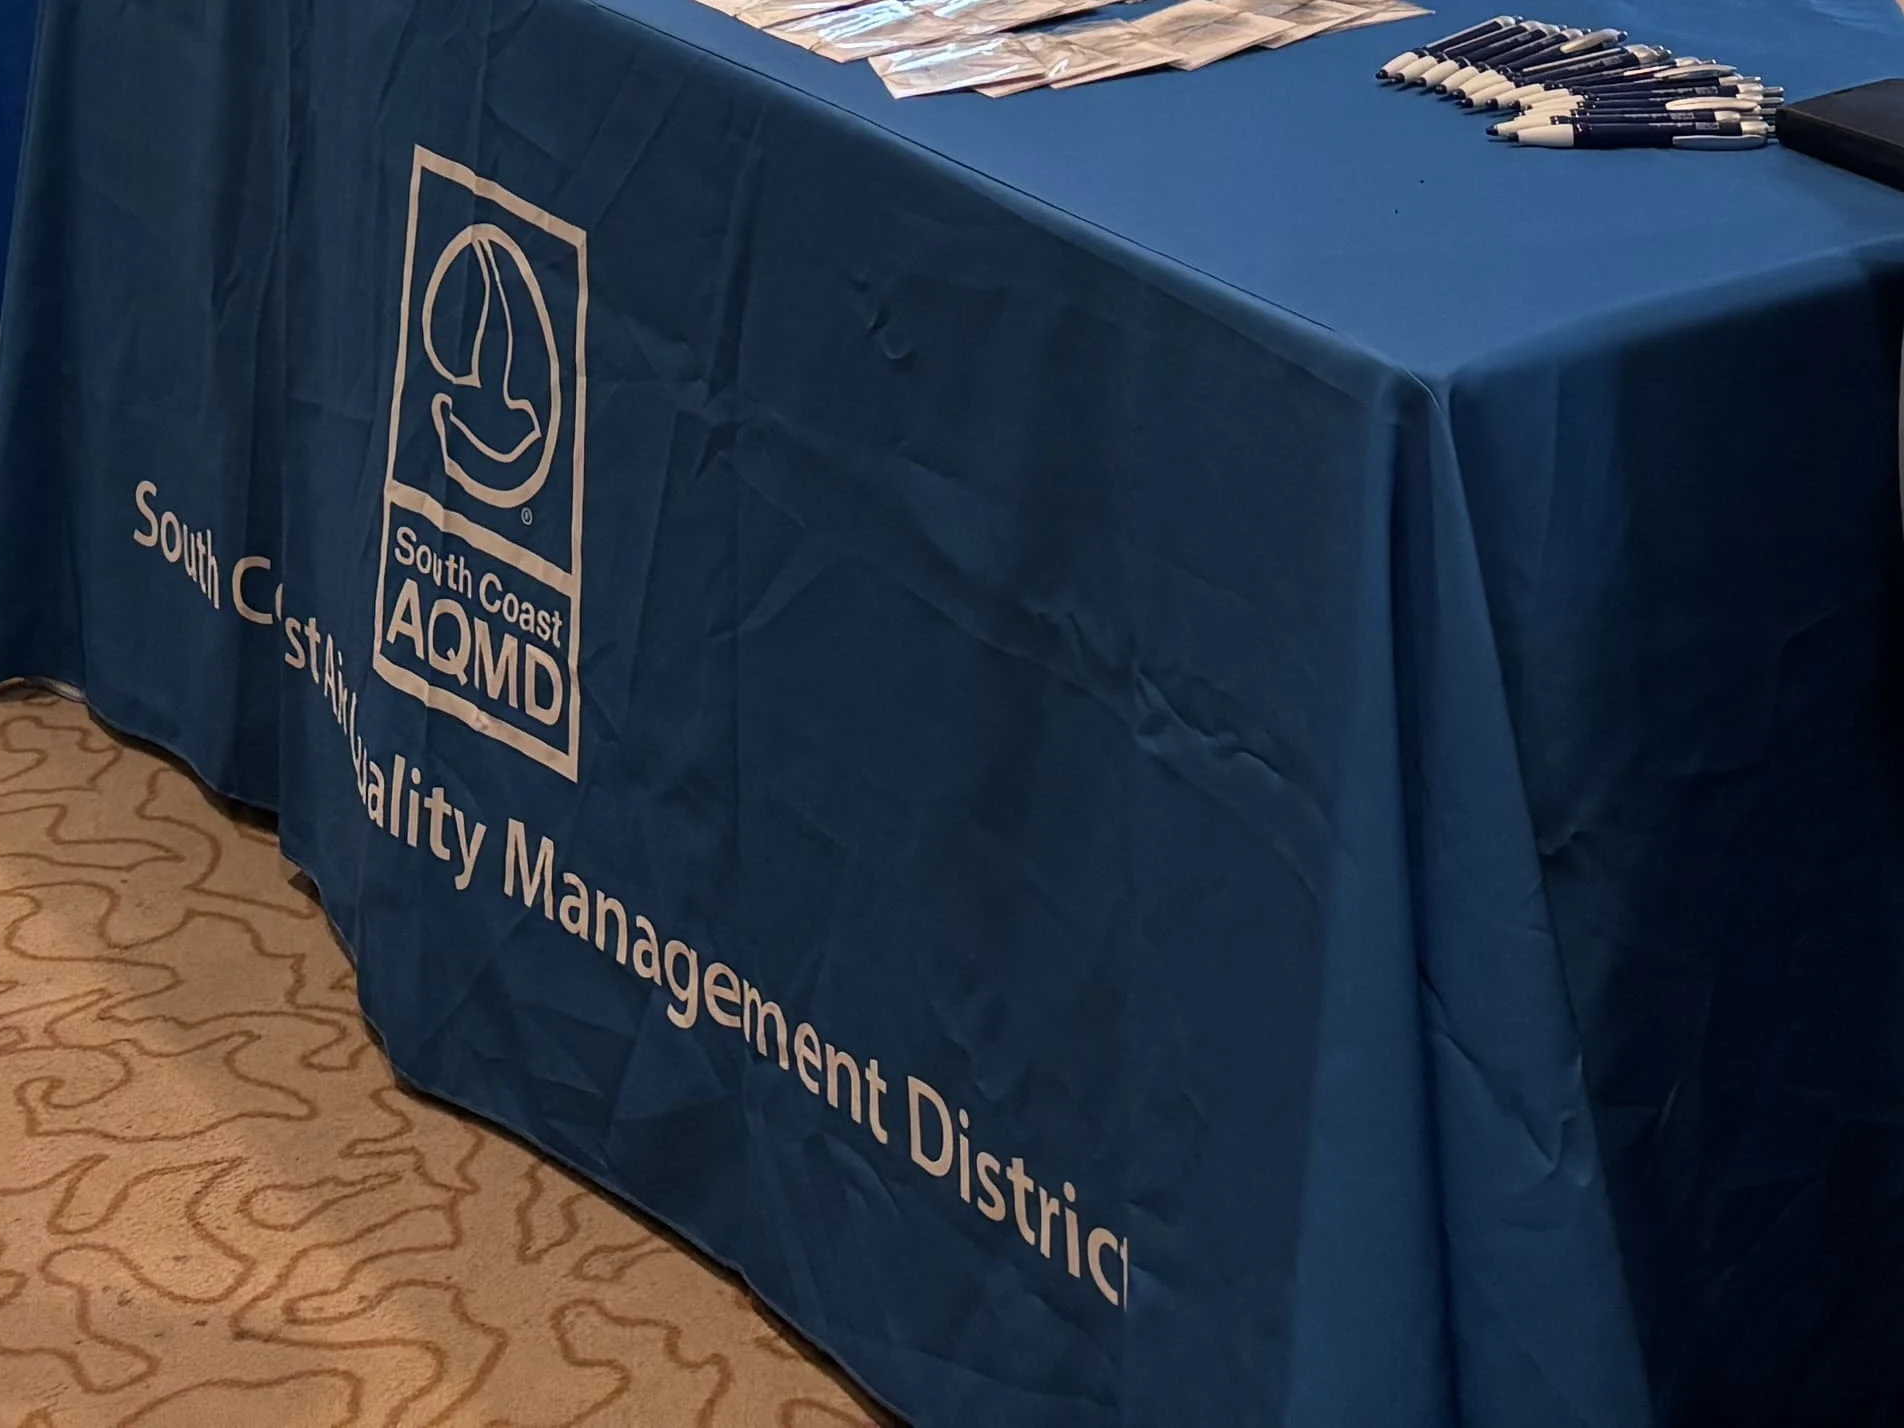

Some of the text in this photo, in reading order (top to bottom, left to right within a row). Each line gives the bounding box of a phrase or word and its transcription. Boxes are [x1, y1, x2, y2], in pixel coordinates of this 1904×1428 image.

[386, 578, 564, 726] AQMD
[395, 526, 563, 648] South Coast
[133, 480, 220, 610] South
[503, 817, 889, 1145] Management
